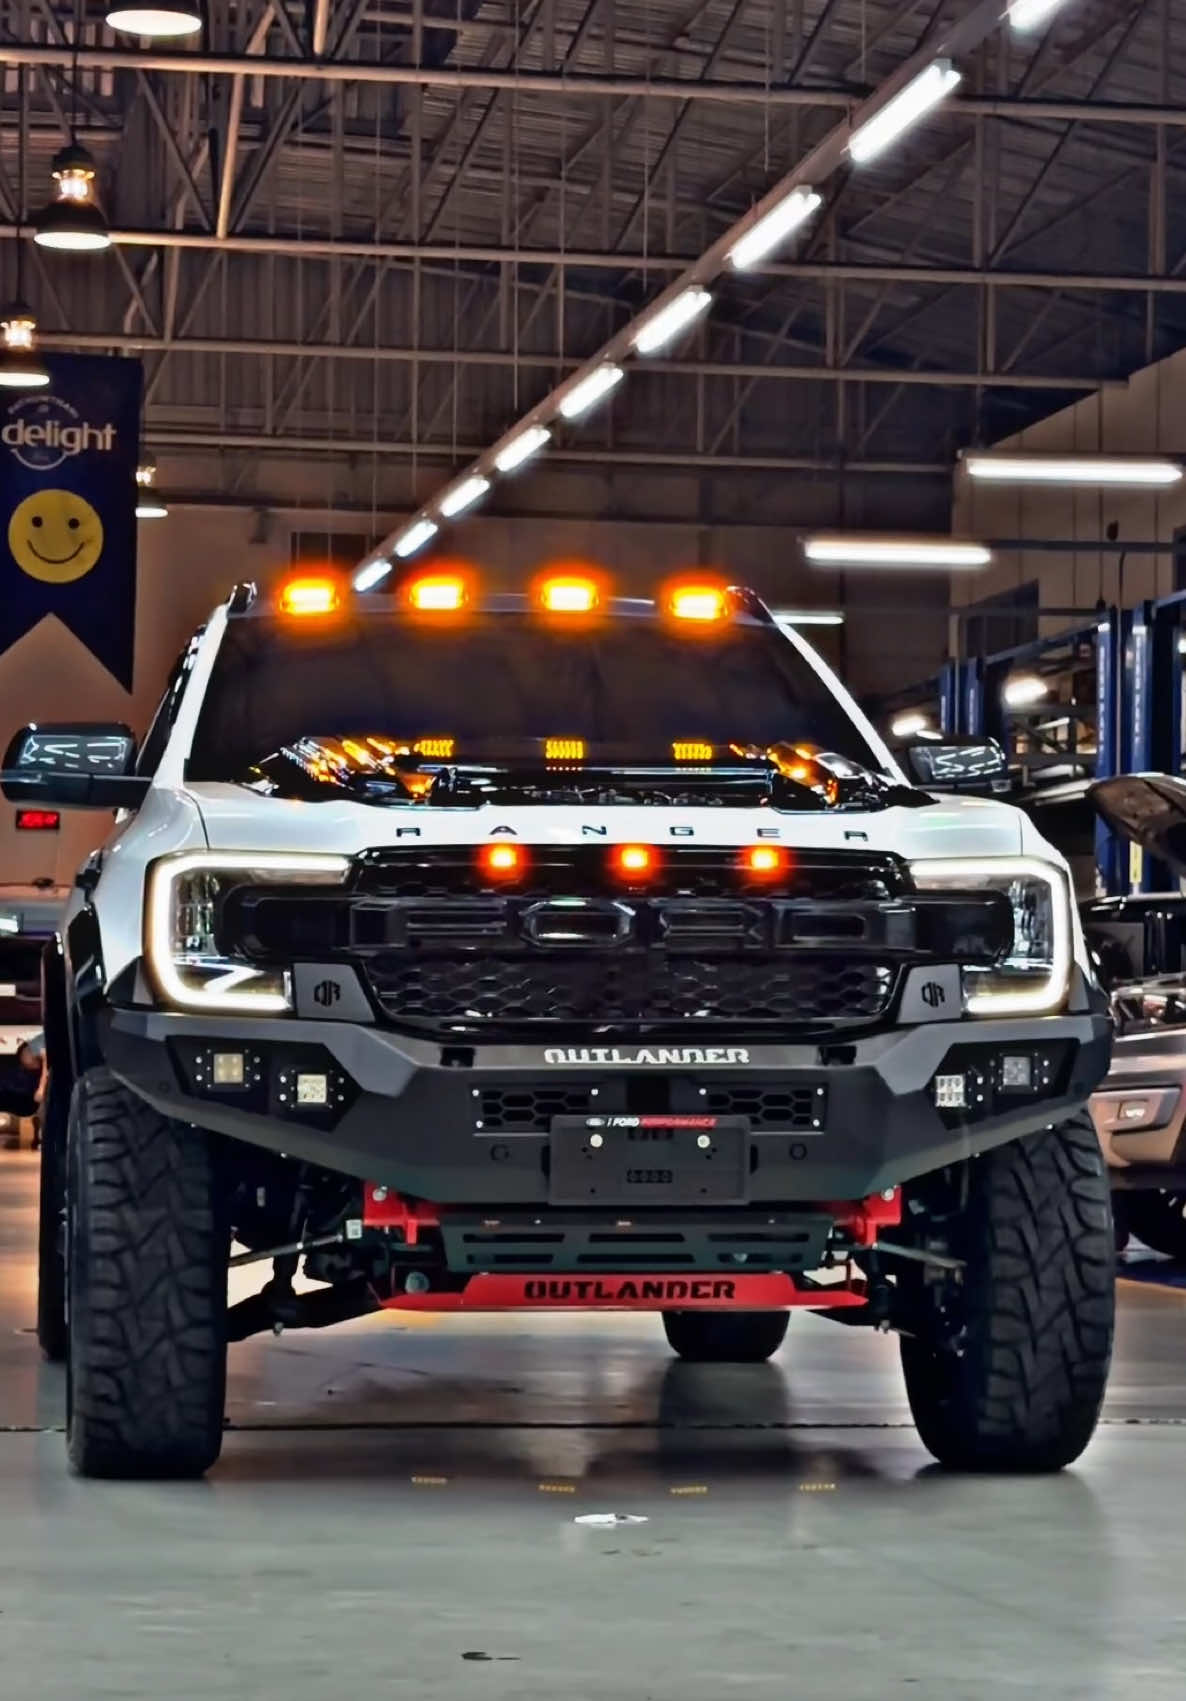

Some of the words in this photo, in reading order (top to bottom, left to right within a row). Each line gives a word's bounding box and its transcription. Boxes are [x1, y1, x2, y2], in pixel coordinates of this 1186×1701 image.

[1, 418, 117, 456] delight
[396, 825, 869, 842] RANGER
[544, 1048, 750, 1064] OUTLANDER
[524, 1280, 736, 1300] OUTLANDER
